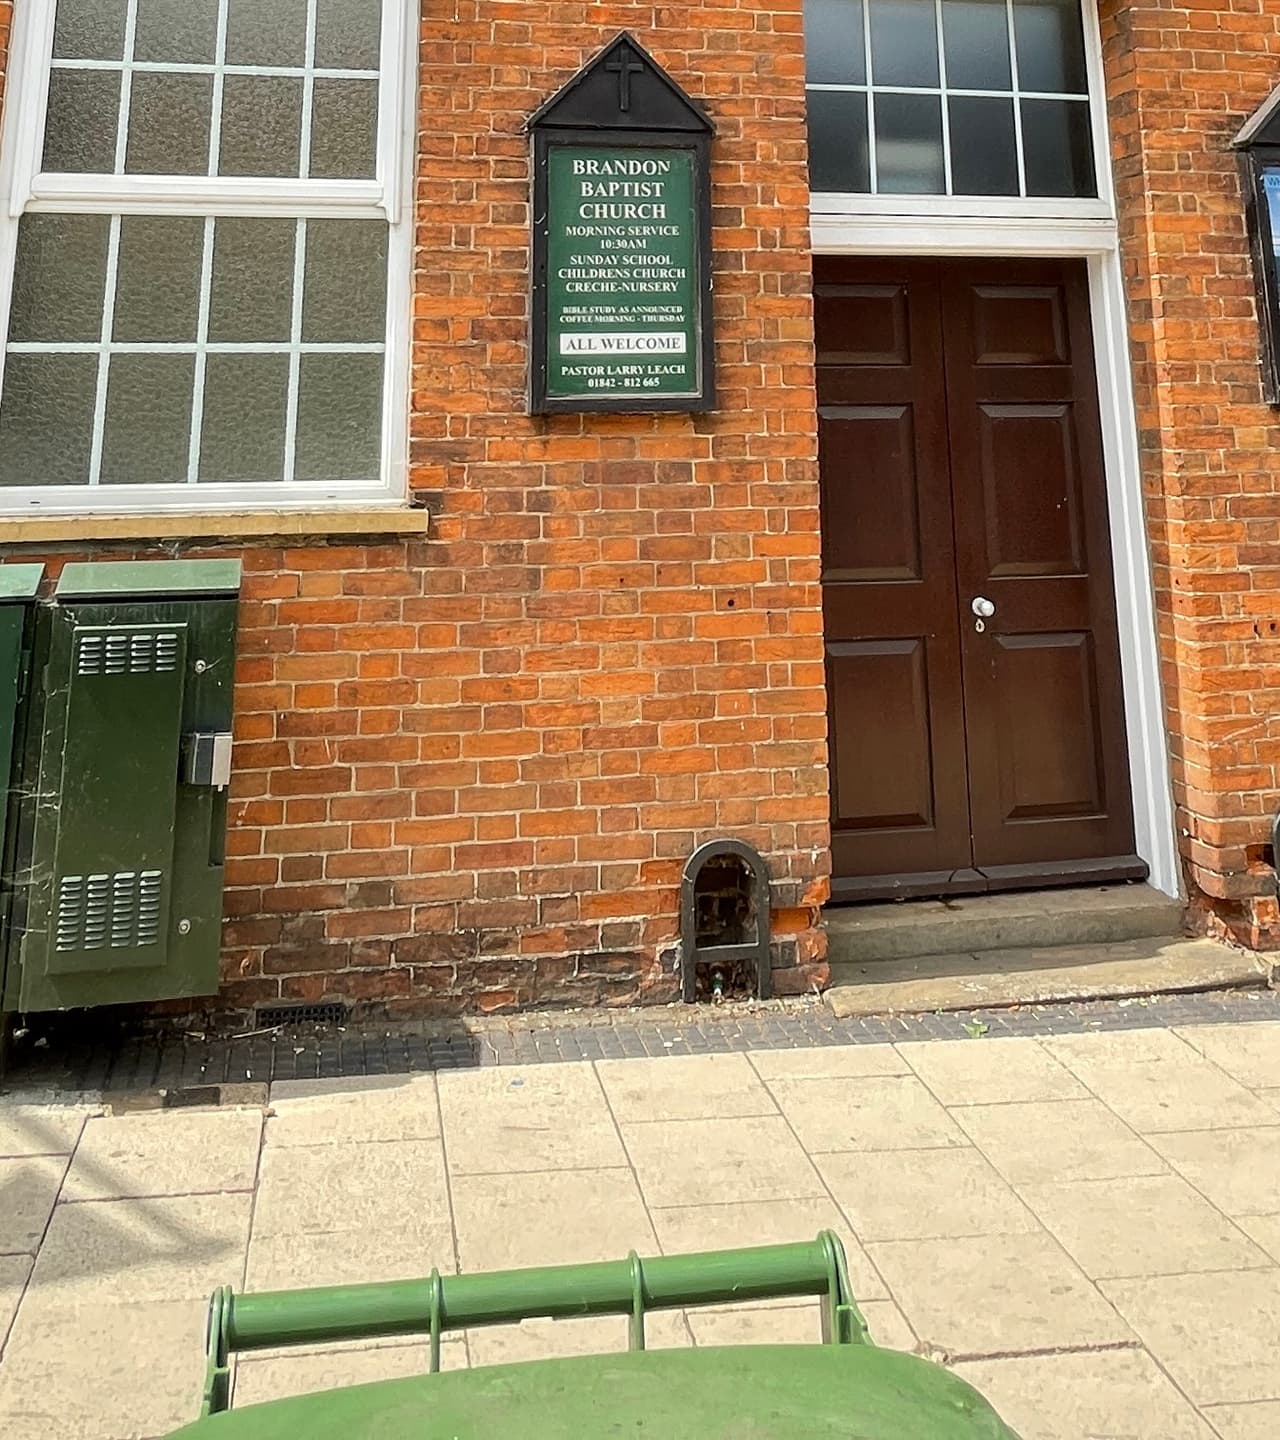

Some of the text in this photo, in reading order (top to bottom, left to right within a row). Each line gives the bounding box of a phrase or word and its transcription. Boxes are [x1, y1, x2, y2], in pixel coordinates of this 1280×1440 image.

[573, 159, 671, 176] BRANDON
[580, 181, 665, 197] BAPTIST
[579, 203, 666, 219] CHURCH
[565, 225, 680, 237] MORNING SERVICE
[600, 239, 647, 249] 10:30AM
[570, 254, 674, 265] SUNDAY SCHOOL
[558, 268, 686, 279] CHILDRENS CHURCH
[565, 281, 679, 292] CRECHE-NURSERY
[562, 306, 588, 314] BIBLE
[590, 306, 616, 314] STUDY
[631, 305, 683, 314] ANNOUNCED
[559, 315, 593, 323] COFFEE
[594, 315, 636, 323] MORNING
[642, 314, 686, 322] THURSDAY
[566, 337, 681, 351] ALL WELCOME
[561, 364, 686, 376] PASTOR LARRY LEACH
[587, 378, 616, 388] 01842
[623, 377, 641, 387] 812
[643, 377, 660, 387] 665
